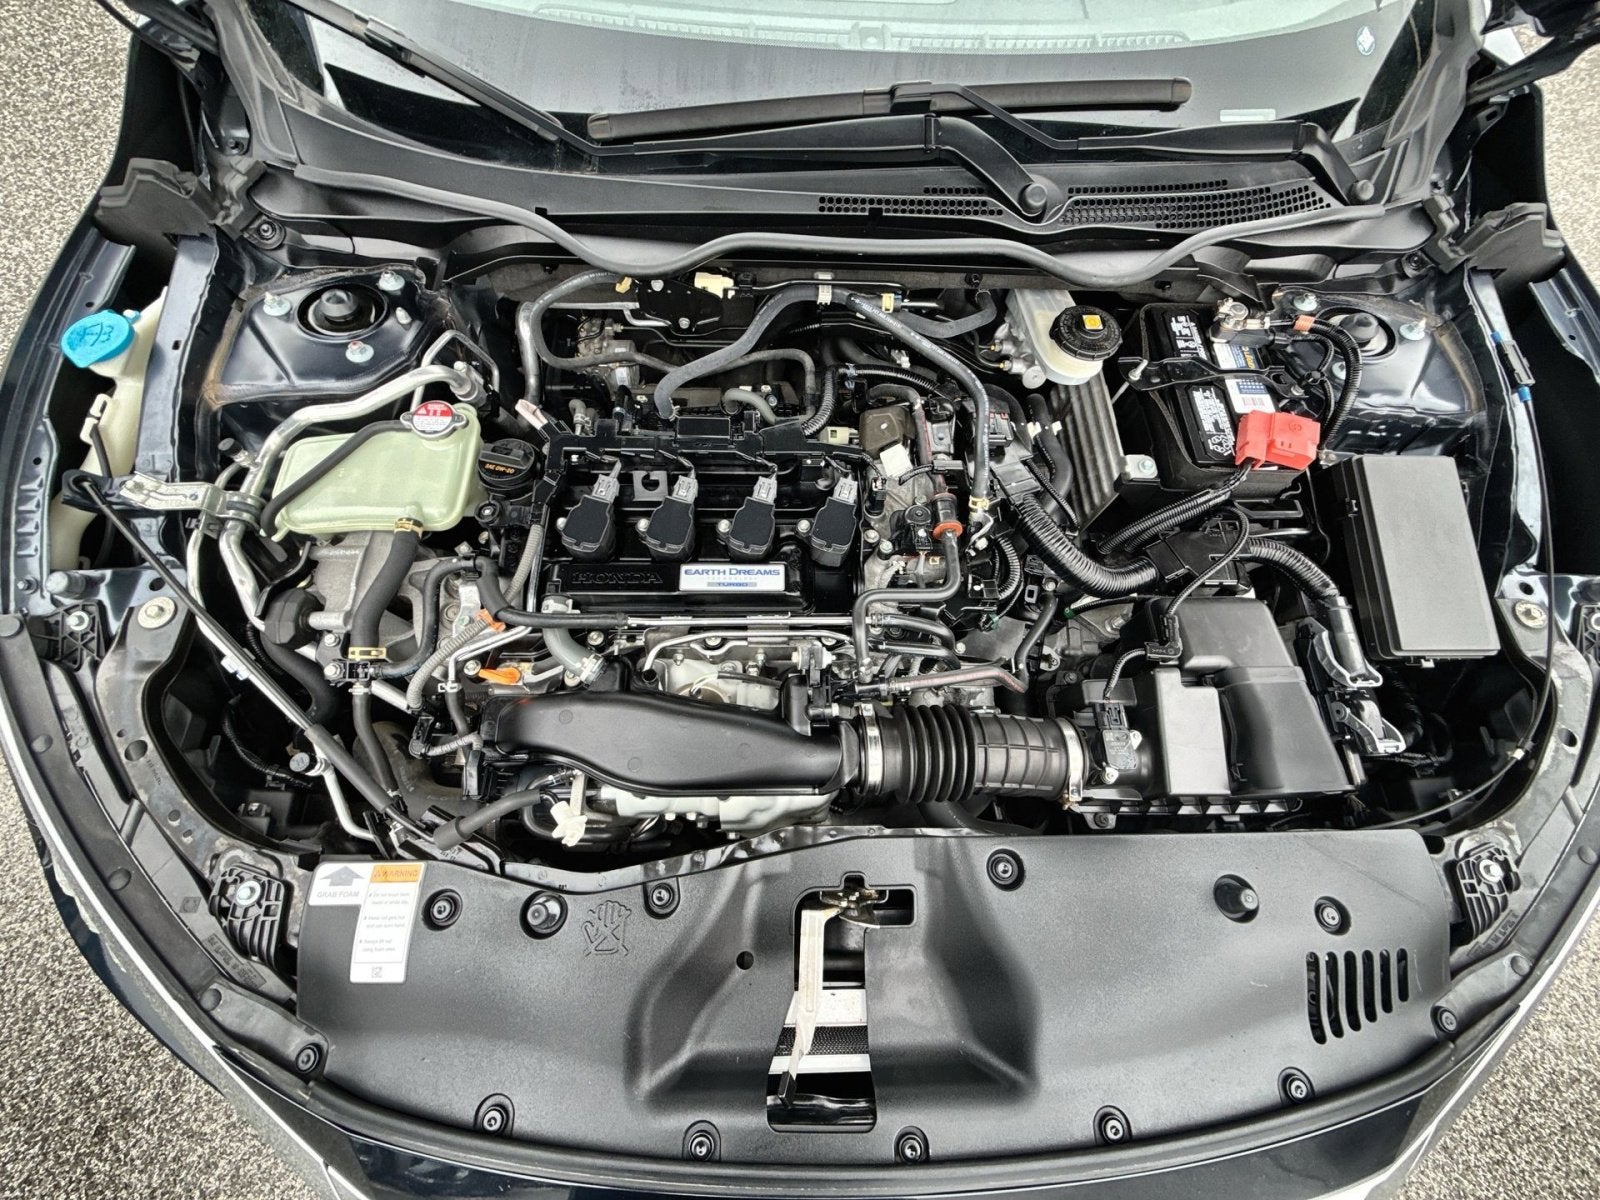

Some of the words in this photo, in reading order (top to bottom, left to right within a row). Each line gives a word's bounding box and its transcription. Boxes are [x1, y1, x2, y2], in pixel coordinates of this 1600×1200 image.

[684, 568, 726, 576] EARTH
[729, 567, 781, 576] DREAMS
[571, 572, 664, 584] HONDA
[382, 869, 419, 878] WARNING
[316, 890, 337, 898] GRAB
[338, 890, 360, 898] FOAM
